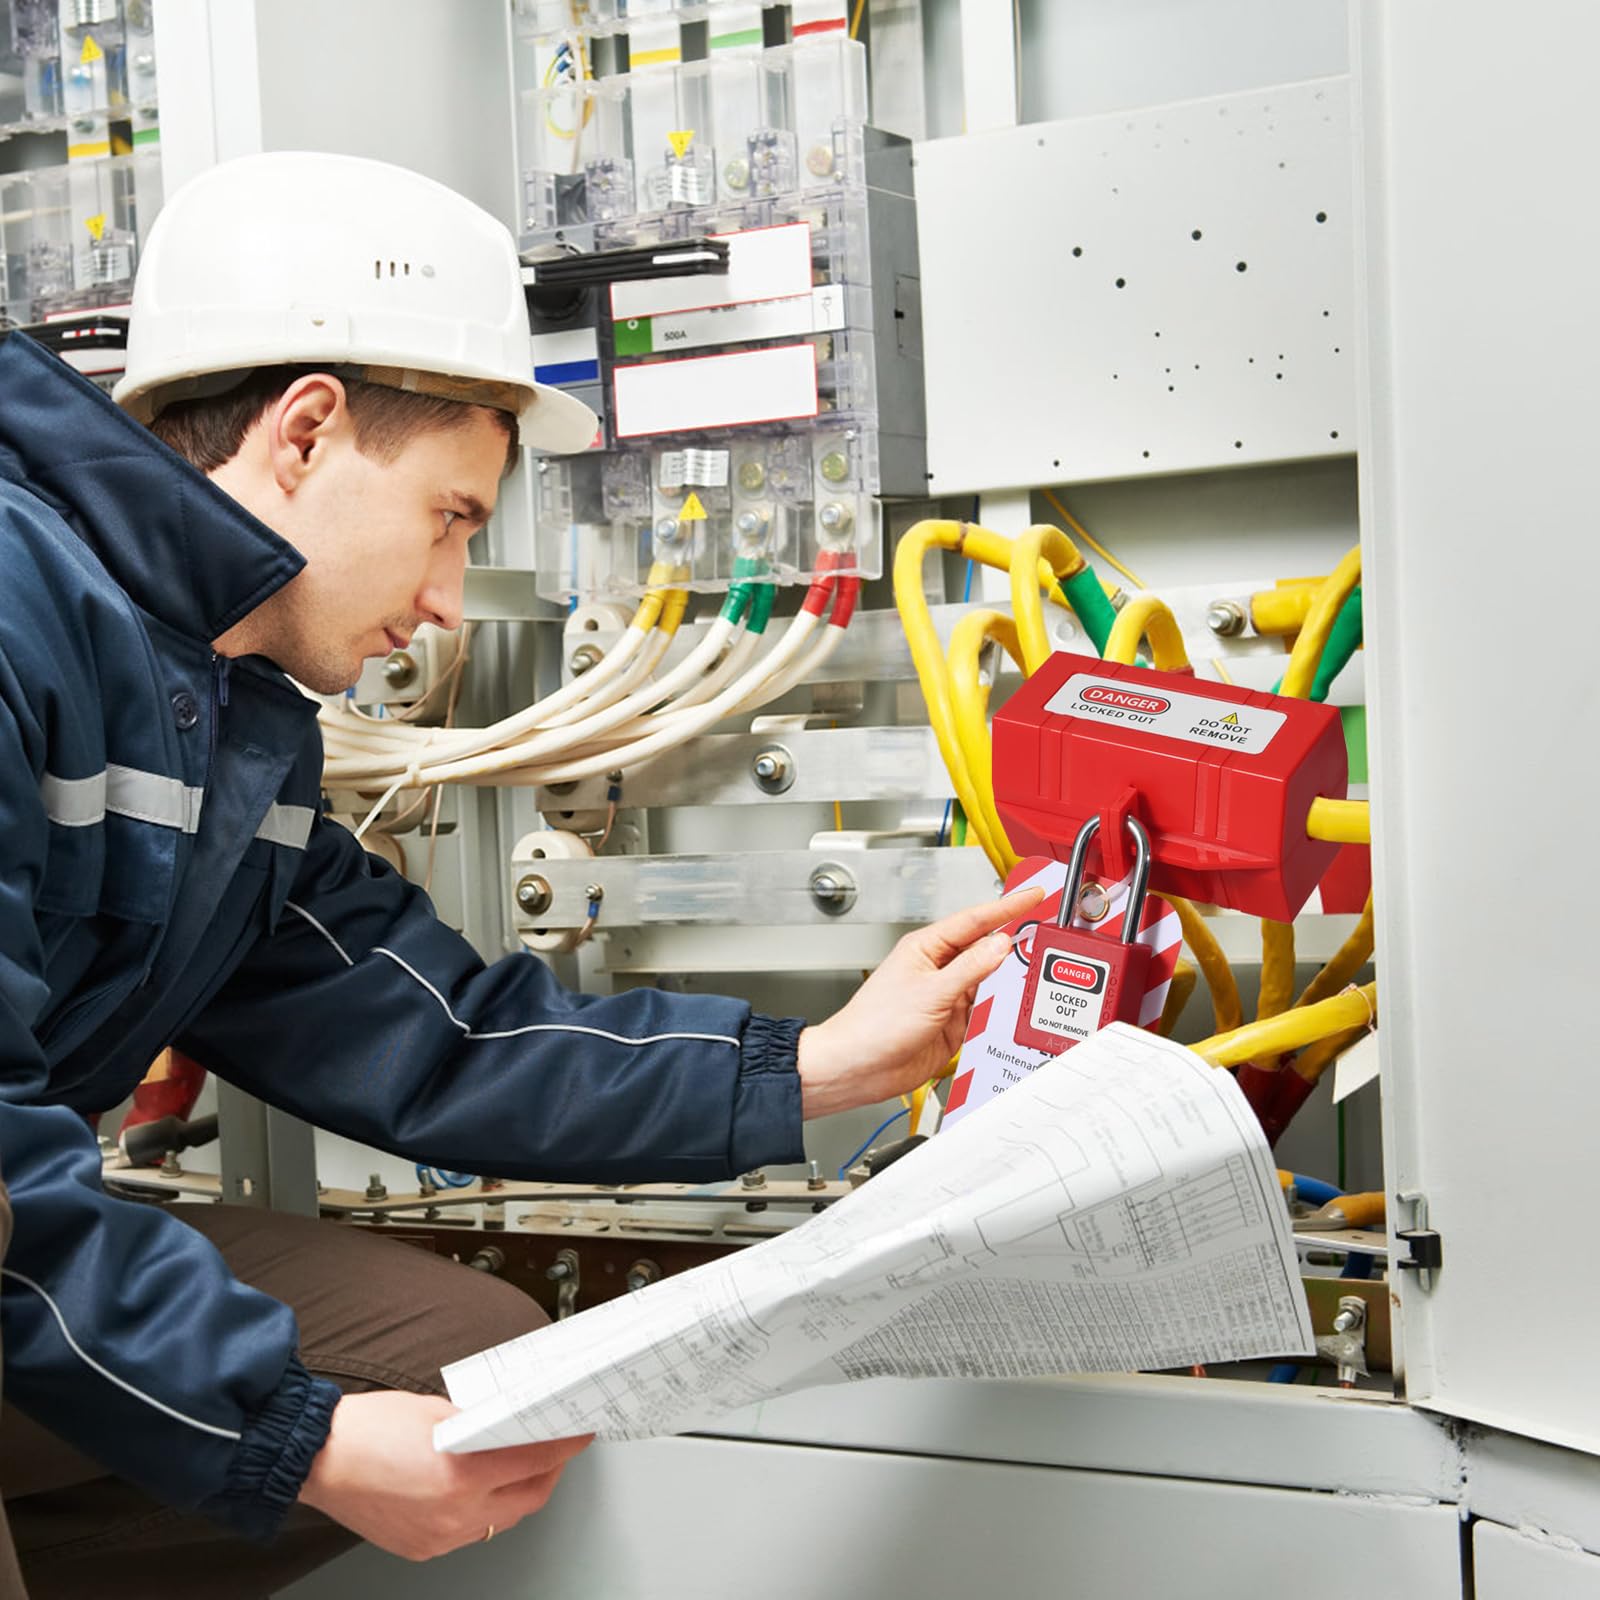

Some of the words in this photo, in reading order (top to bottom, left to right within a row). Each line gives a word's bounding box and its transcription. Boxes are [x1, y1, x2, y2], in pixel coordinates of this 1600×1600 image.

[664, 330, 687, 341] 500A
[1089, 690, 1160, 711] DANGER
[1070, 702, 1125, 719] LOCKED
[1127, 714, 1157, 725] OUT
[1198, 719, 1218, 729] DO
[1222, 723, 1253, 735] NOT
[1189, 727, 1249, 745] REMOVE
[1057, 965, 1092, 981] DANGER
[1049, 991, 1088, 1008] LOCKED
[1056, 1005, 1078, 1018] OUT
[1038, 1018, 1048, 1026] DO
[1048, 1020, 1062, 1030] NOT
[1063, 1023, 1089, 1037] REMOVE
[1002, 1068, 1022, 1083] This
